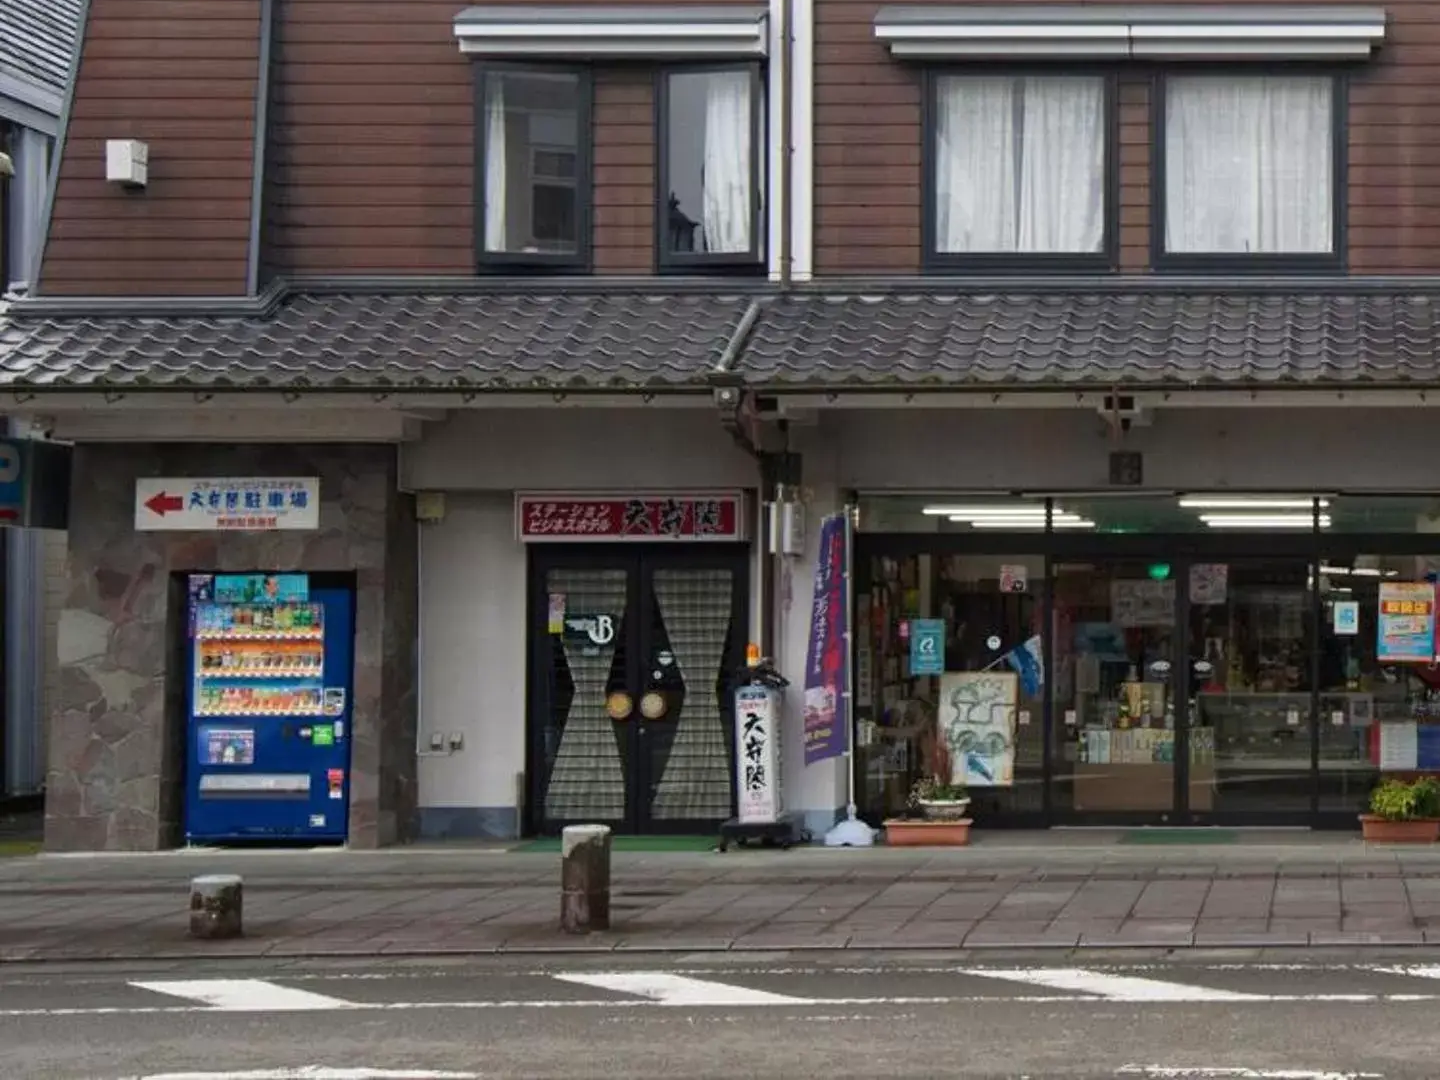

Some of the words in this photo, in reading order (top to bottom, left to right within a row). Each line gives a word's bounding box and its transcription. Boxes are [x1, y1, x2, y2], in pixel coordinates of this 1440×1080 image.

[529, 504, 611, 518] ステーション
[529, 519, 612, 533] ビジネスホテル
